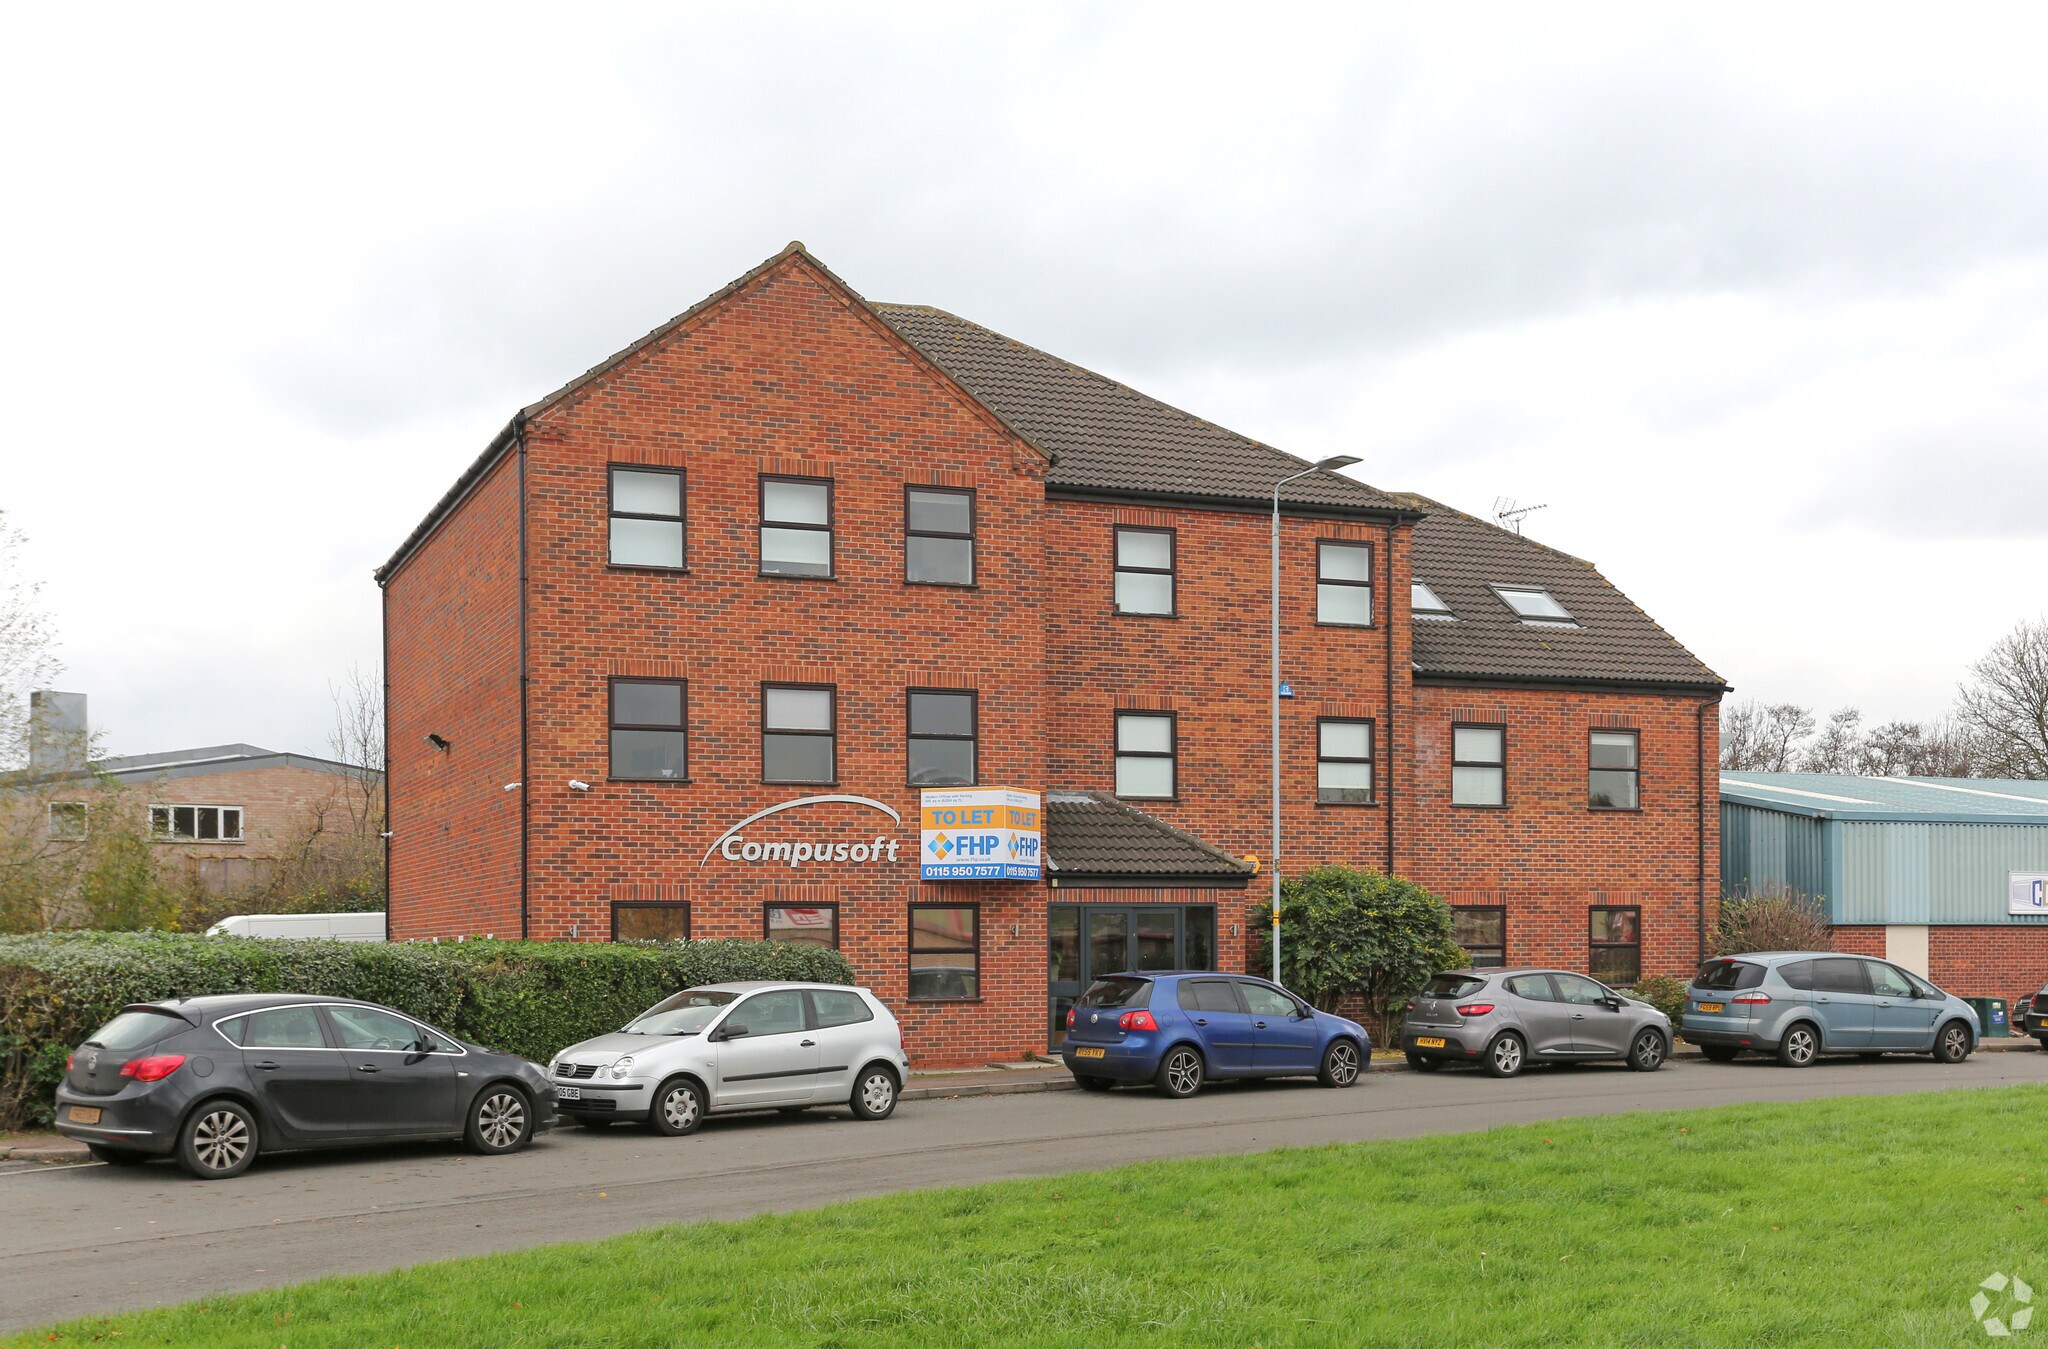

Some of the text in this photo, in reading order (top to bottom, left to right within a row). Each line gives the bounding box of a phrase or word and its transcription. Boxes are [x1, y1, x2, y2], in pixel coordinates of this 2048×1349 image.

[932, 809, 995, 825] TO LET
[1009, 810, 1037, 827] TO LET
[721, 835, 899, 868] Compusoft
[956, 835, 1000, 856] FHP
[1019, 837, 1038, 857] FHP
[925, 866, 1000, 876] 0115 950 7577
[1006, 868, 1039, 877] 0115 950 7577
[567, 1088, 579, 1098] GBE
